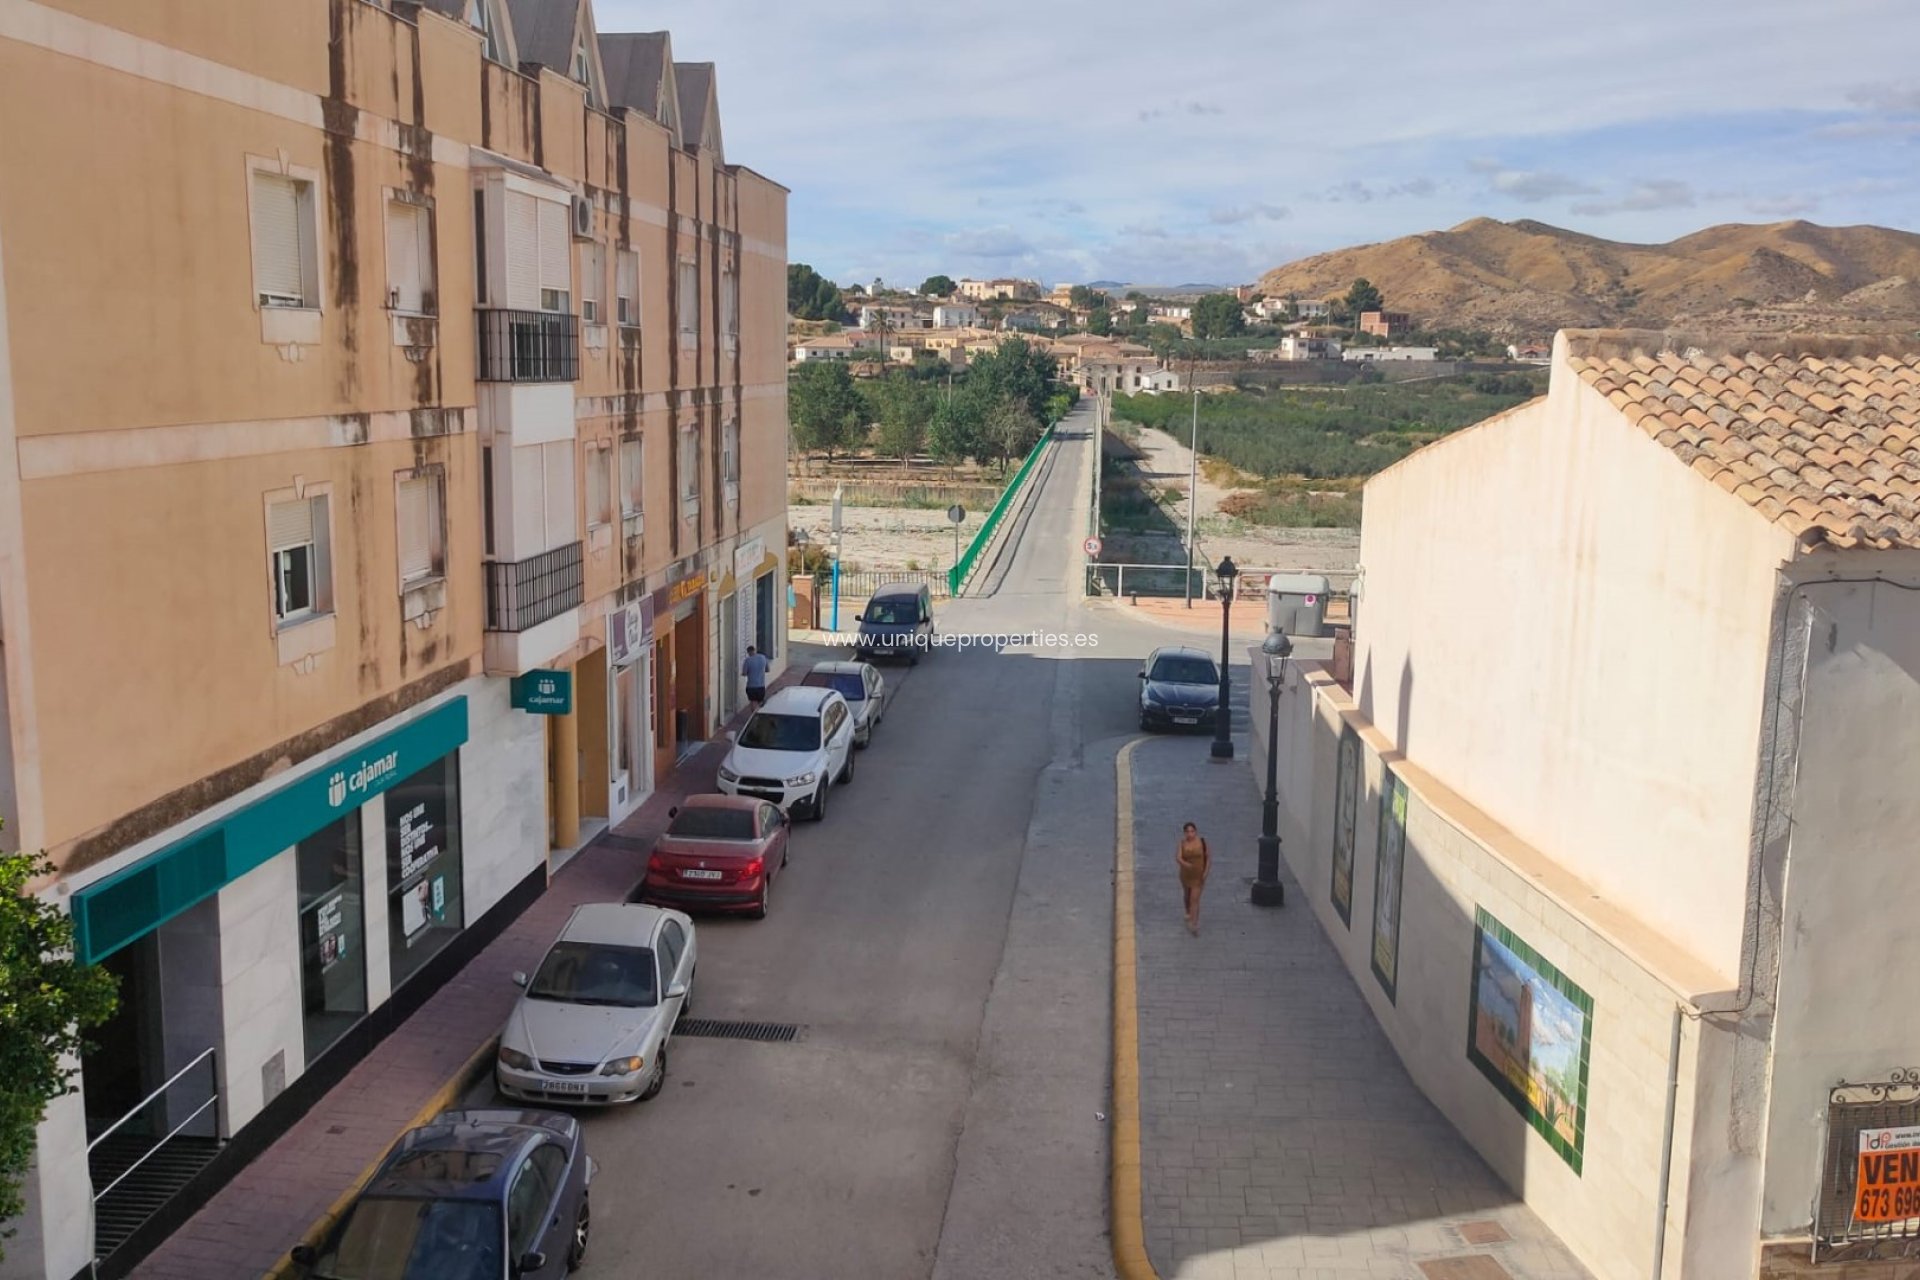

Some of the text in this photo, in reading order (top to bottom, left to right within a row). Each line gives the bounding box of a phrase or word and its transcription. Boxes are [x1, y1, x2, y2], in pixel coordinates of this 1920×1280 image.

[529, 696, 564, 705] cajamar
[349, 751, 398, 792] cajamar
[1864, 1152, 1919, 1185] VEN
[1860, 1185, 1920, 1217] 673 696
